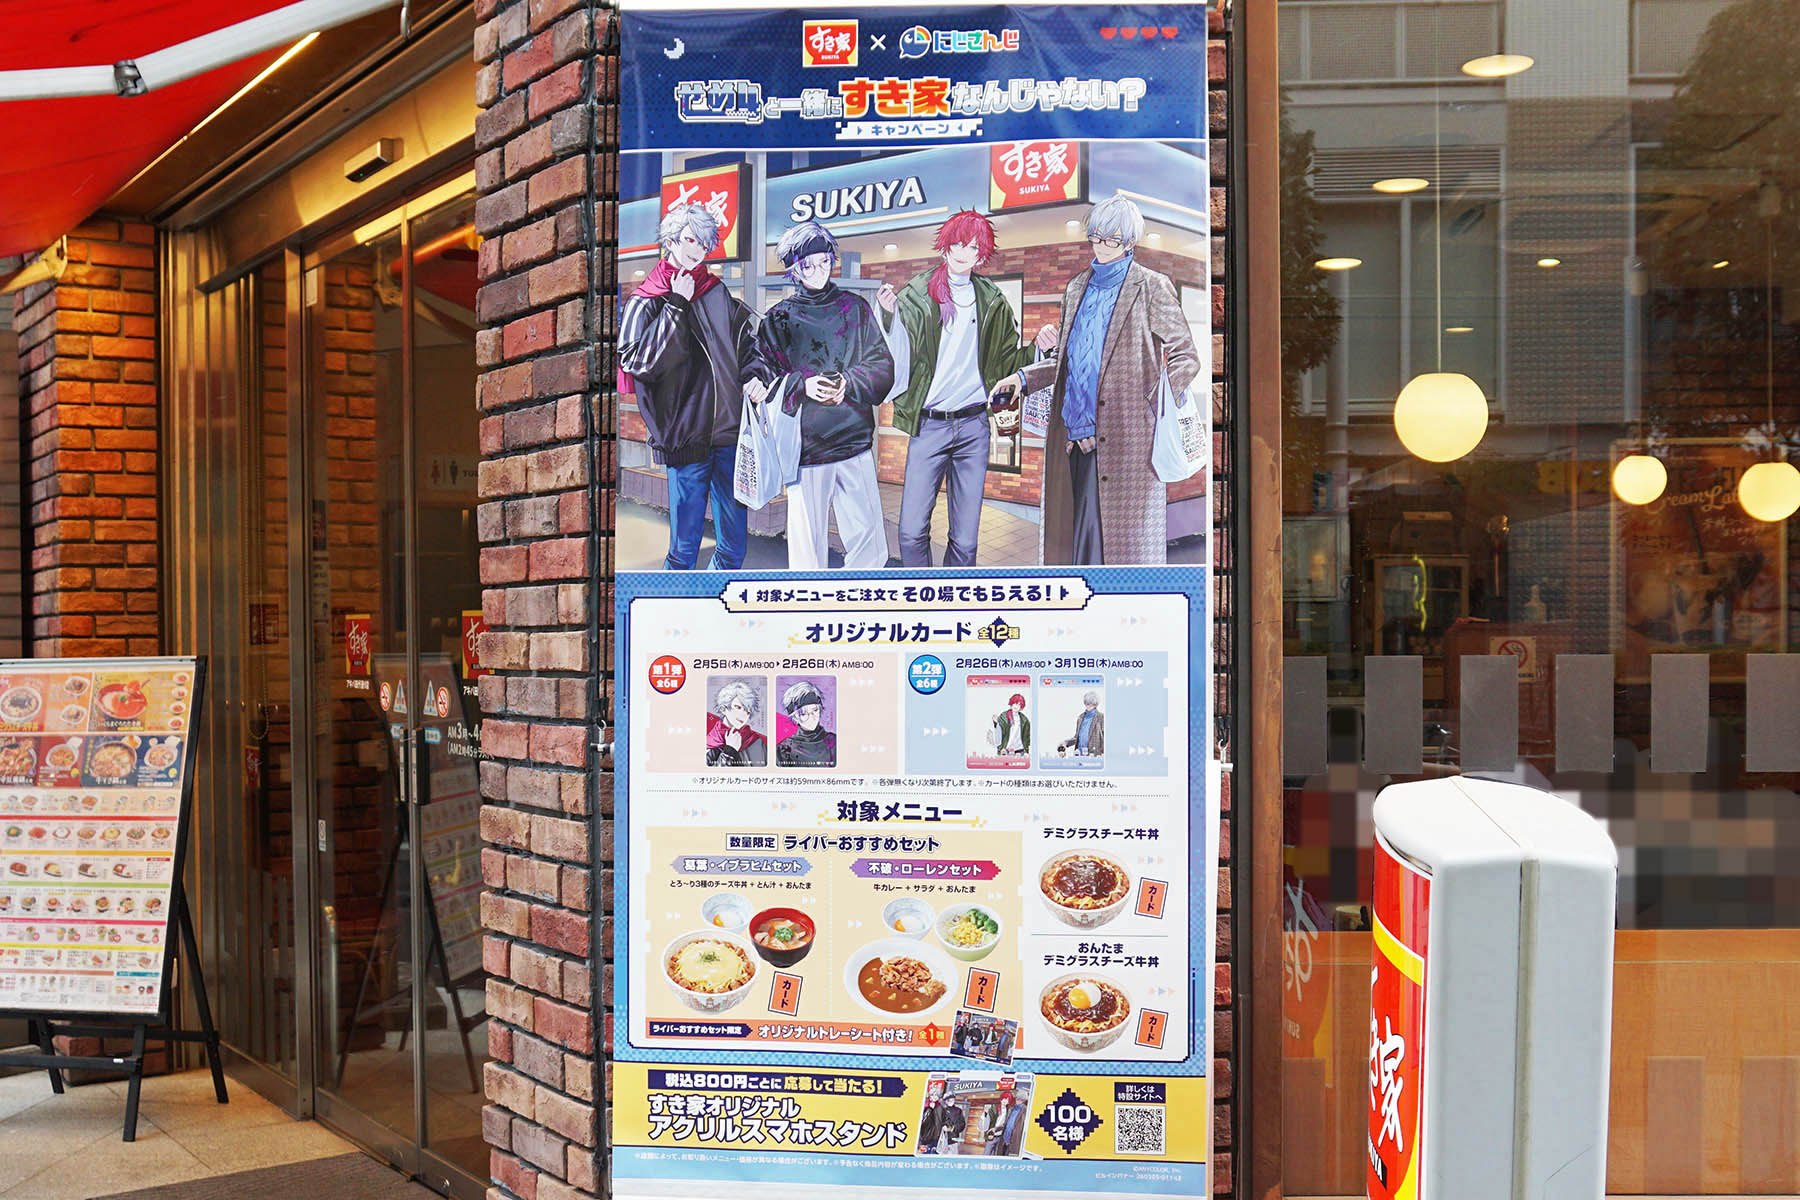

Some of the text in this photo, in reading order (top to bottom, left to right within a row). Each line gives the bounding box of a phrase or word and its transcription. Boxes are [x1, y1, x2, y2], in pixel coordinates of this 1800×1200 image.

[808, 26, 851, 54] すき家
[932, 29, 1020, 53] にじさんじ
[870, 124, 950, 136] キャンペーン
[1000, 143, 1069, 183] すき家
[1019, 185, 1051, 195] SUKIYA
[790, 176, 927, 223] SUKIYA
[756, 585, 1052, 603] 対象メニューをご注文で その場でもらえる!
[805, 622, 972, 643] オリジナルカード
[836, 800, 963, 822] 対象メニュー
[1043, 827, 1160, 840] デミグラスチーズ牛丼
[729, 835, 940, 852] 数量限定 ライバーおすすめセット
[683, 859, 802, 873] 葛葉・イブラヒムセット
[867, 862, 983, 877] 不破・ローレンセット
[756, 881, 777, 889] とん汁
[785, 881, 812, 890] おんたま
[873, 884, 904, 892] 牛カレー
[913, 884, 936, 893] サラダ
[946, 885, 976, 894] おんたま
[1147, 885, 1158, 912] カード
[1078, 943, 1124, 955] おんたま
[1043, 955, 1160, 968] デミグラスチーズ牛丼
[780, 980, 792, 1009] カード
[976, 976, 989, 1005] カード
[652, 1024, 743, 1036] ライバーおすすめセット限定
[758, 1025, 913, 1043] オリジナルトレーシート付き!
[1146, 1016, 1158, 1042] カード
[954, 1081, 983, 1090] SUKIYA
[1125, 1085, 1154, 1093] 詳しくは
[1117, 1092, 1163, 1101] 特設サイトへ
[648, 1094, 801, 1119] すき家オリジナル
[1045, 1104, 1092, 1123] 100
[649, 1114, 909, 1149] アクリルスマホスタンド
[1052, 1125, 1085, 1142] 名様
